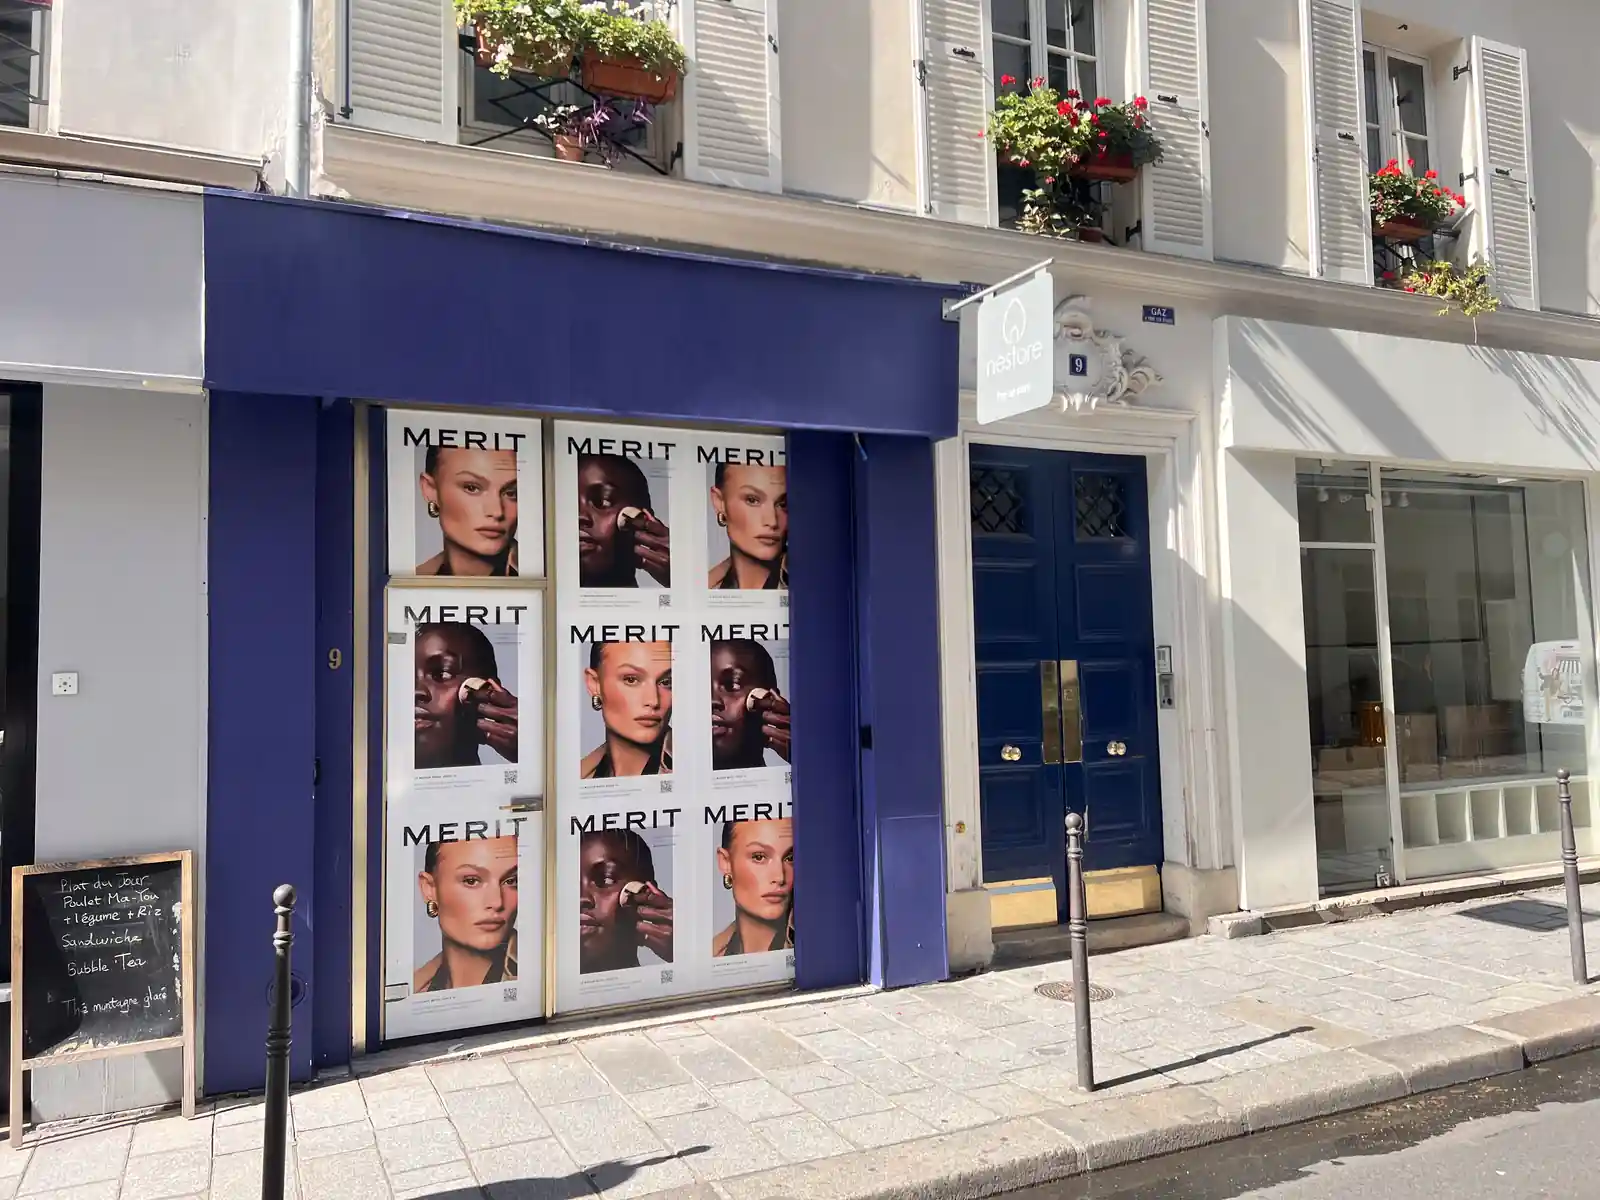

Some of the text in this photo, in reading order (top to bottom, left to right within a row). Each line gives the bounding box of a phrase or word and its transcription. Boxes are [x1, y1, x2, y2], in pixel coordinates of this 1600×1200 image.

[1151, 307, 1167, 317] GAZ
[986, 340, 1043, 378] nestore
[1075, 357, 1083, 373] 9
[403, 427, 526, 453] MERIT
[567, 436, 676, 460] MERIT
[403, 605, 528, 626] MERIT
[570, 624, 680, 644] MERIT
[328, 648, 342, 670] 9
[403, 817, 528, 847] MERIT
[570, 808, 681, 835] MERIT
[60, 872, 150, 893] Plat du Jour
[63, 896, 102, 909] Poulet
[67, 952, 147, 977] Bubble Tea
